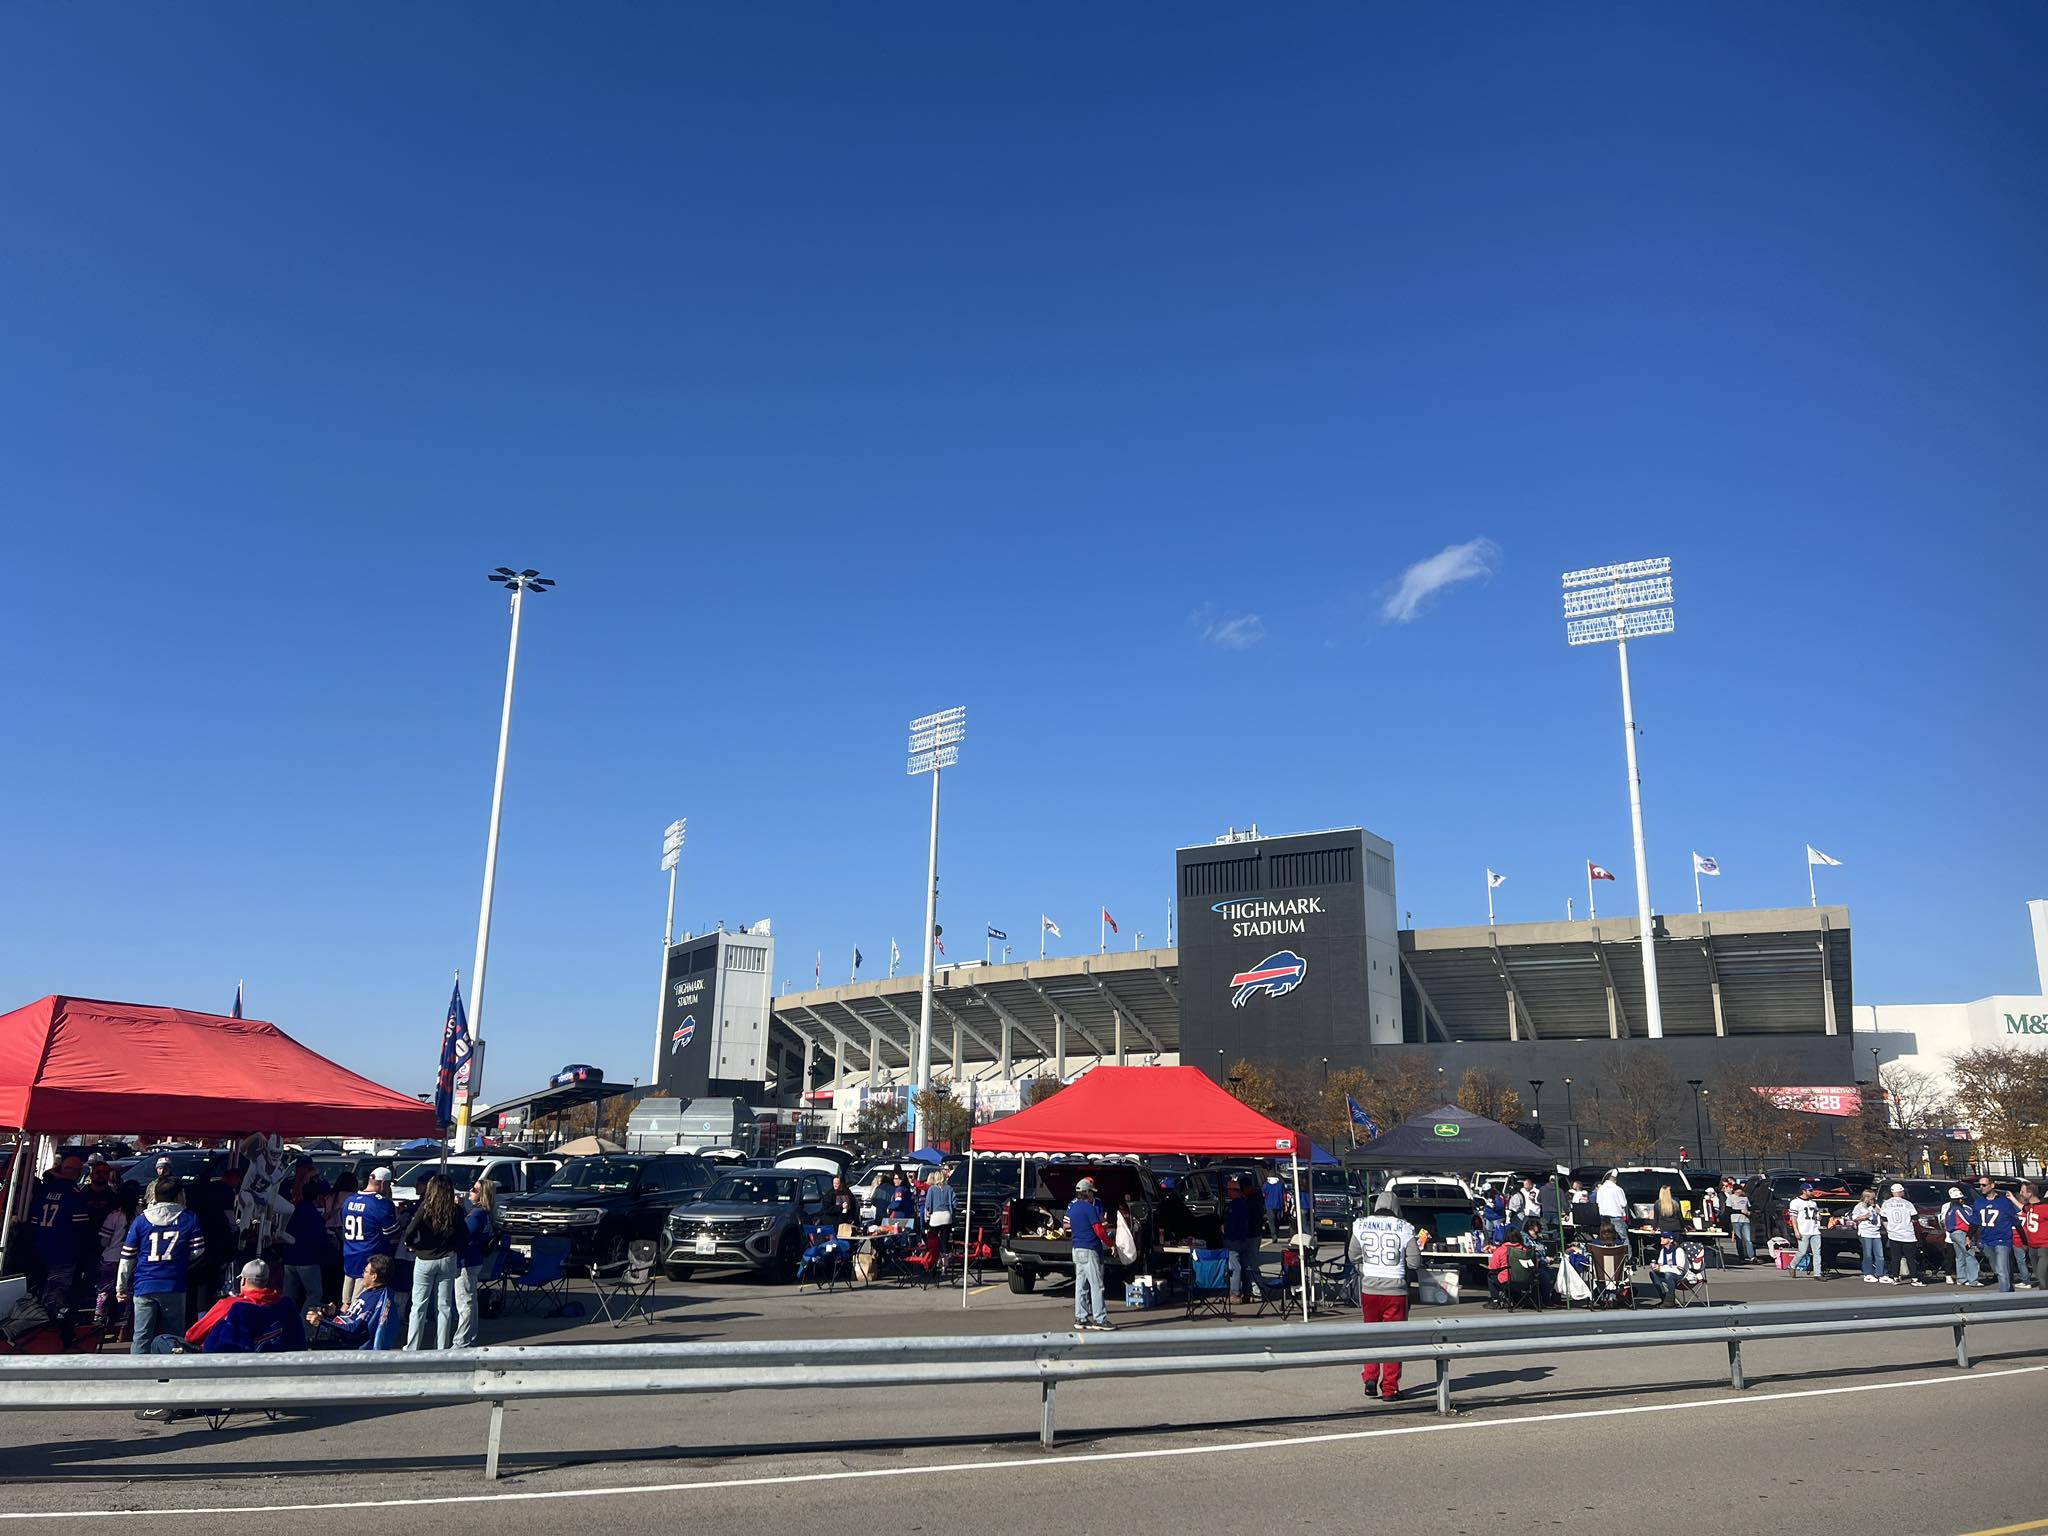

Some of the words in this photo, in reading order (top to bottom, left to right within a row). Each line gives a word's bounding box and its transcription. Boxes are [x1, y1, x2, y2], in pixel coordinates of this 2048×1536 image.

[1233, 918, 1305, 938] STADIUM
[677, 993, 699, 1008] STADIUM
[40, 1203, 59, 1227] 17
[1980, 1209, 1999, 1227] 17
[345, 1214, 364, 1241] 91
[147, 1231, 180, 1262] 17
[1360, 1231, 1401, 1266] 28
